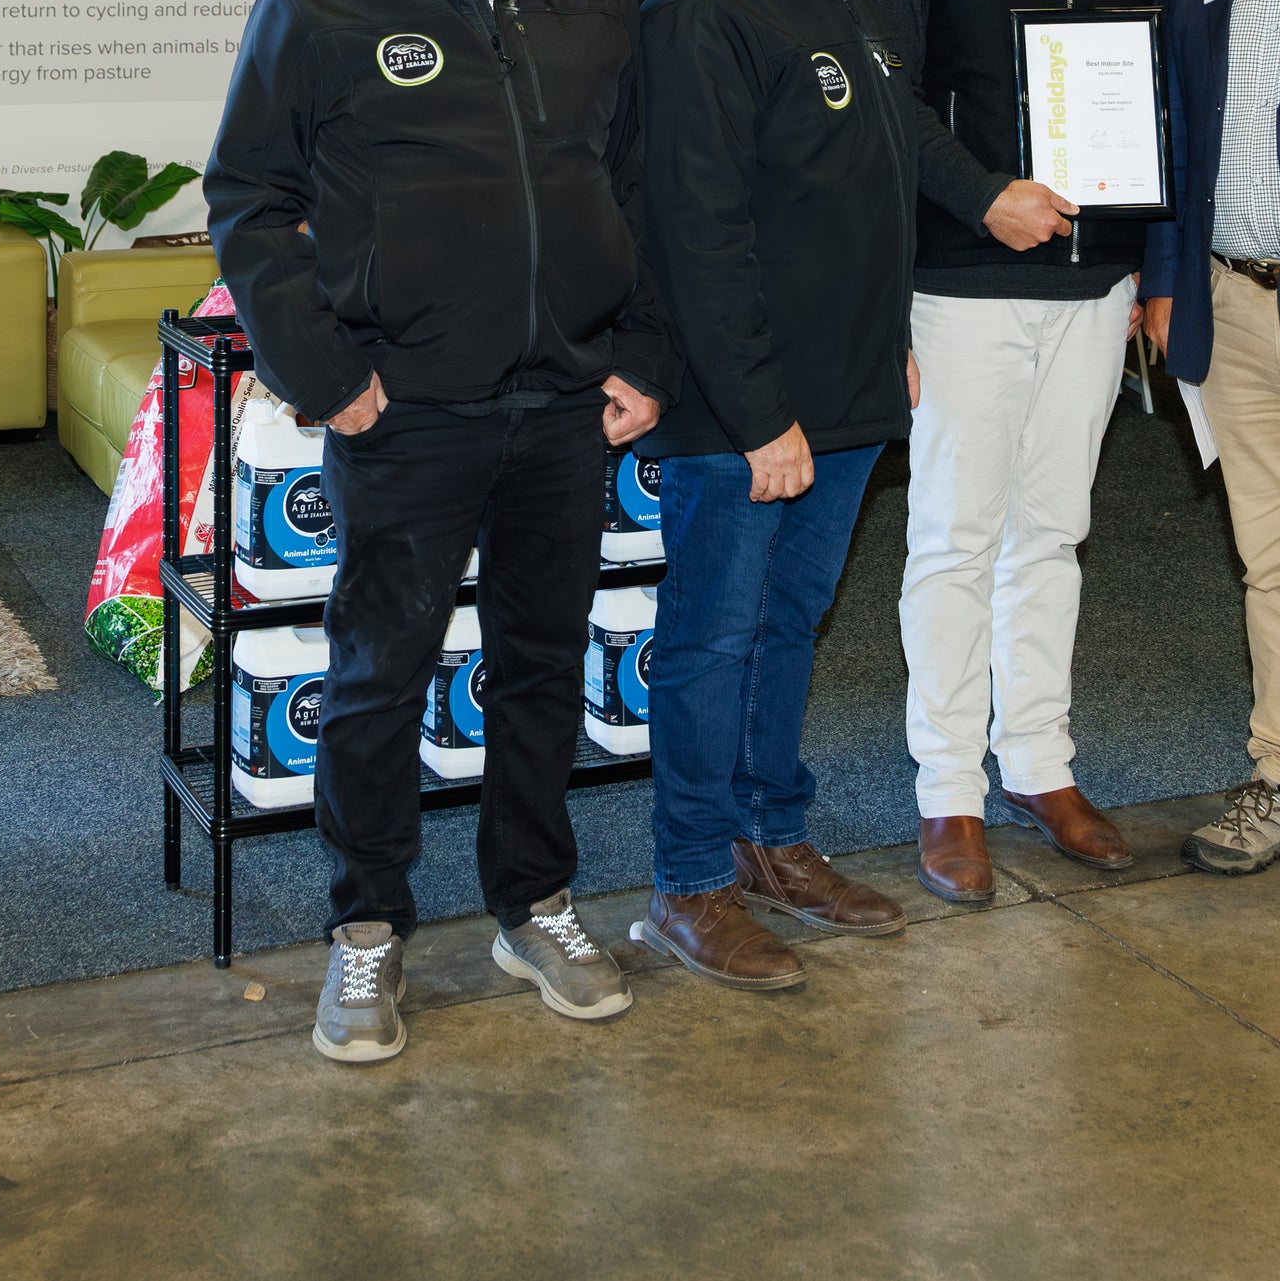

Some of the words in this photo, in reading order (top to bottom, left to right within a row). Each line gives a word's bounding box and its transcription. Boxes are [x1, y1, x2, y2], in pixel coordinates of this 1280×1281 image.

[388, 52, 433, 65] AgriSea
[1047, 39, 1068, 140] Fieldays
[1054, 147, 1068, 190] 2026
